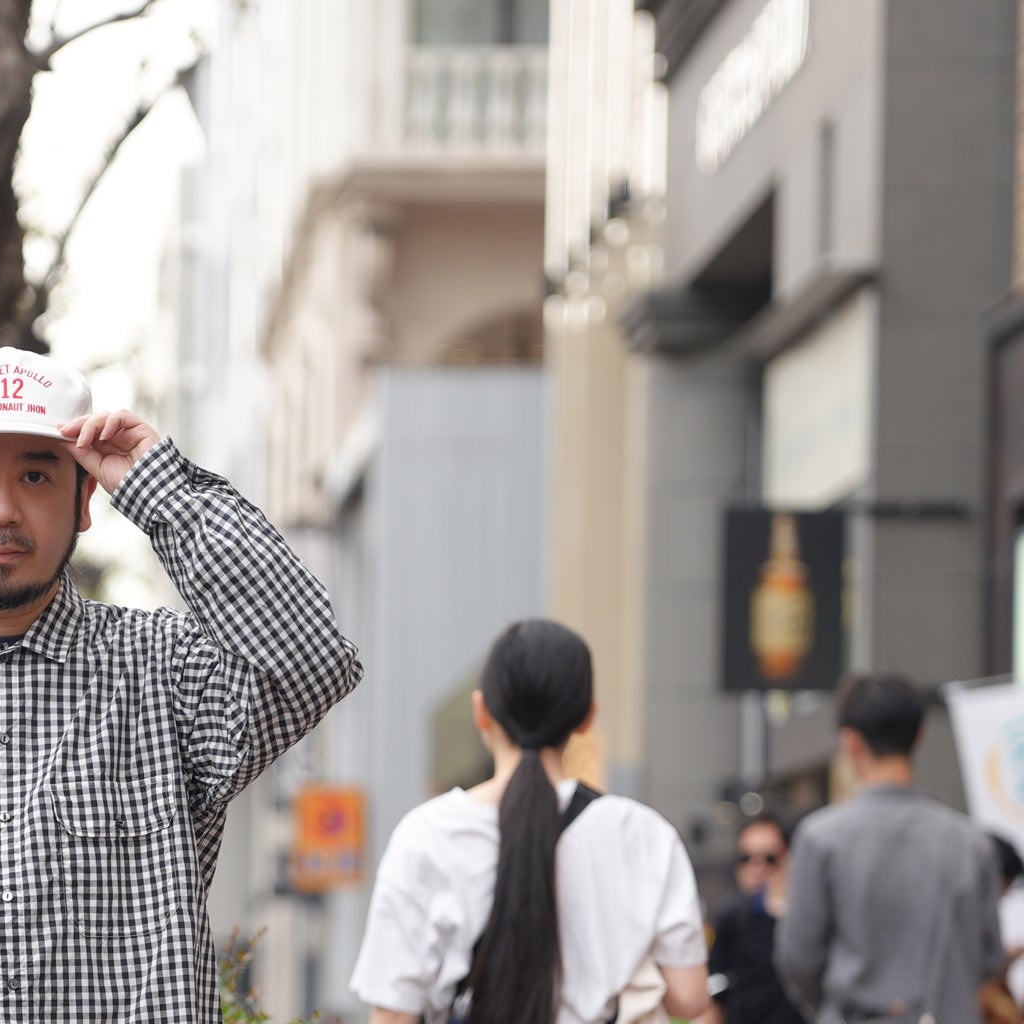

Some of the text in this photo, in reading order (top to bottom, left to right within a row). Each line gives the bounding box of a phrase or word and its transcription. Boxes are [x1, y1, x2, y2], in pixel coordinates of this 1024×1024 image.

[13, 365, 53, 388] APOLLO
[0, 378, 24, 399] 12
[26, 403, 46, 415] JHON
